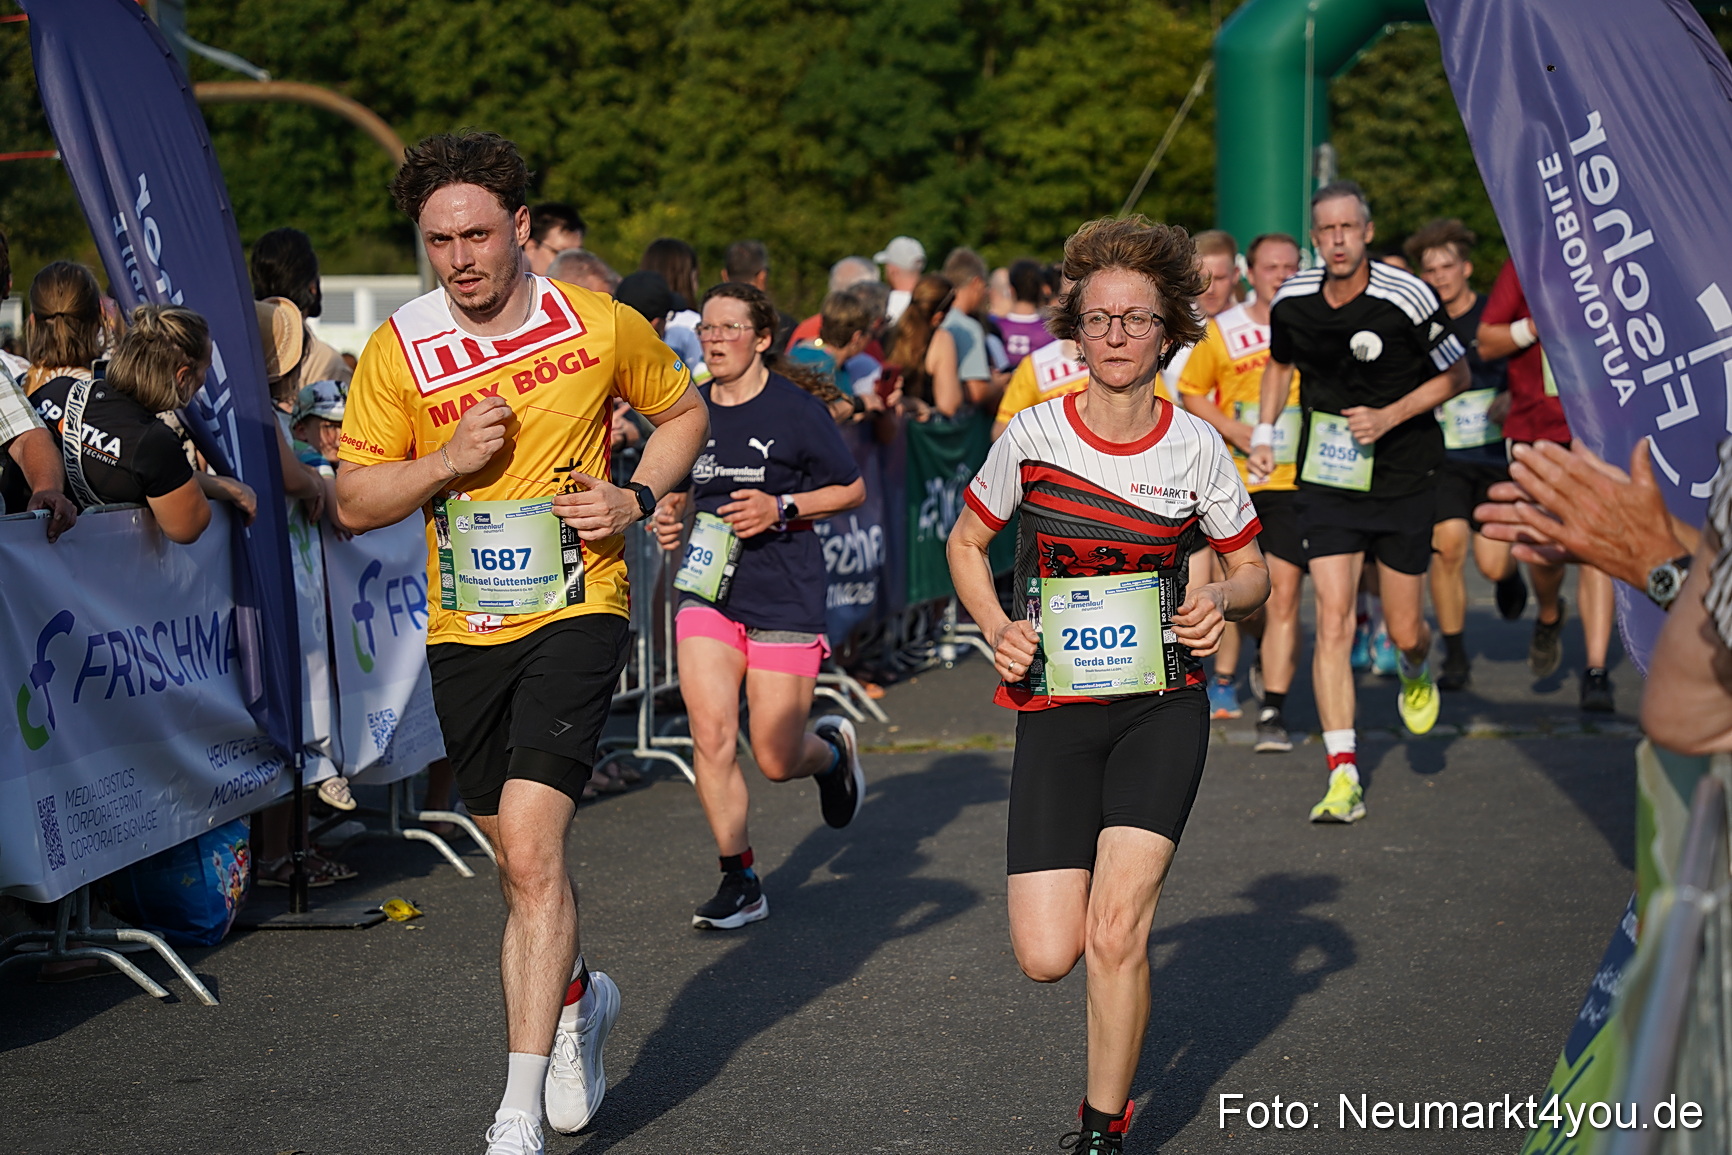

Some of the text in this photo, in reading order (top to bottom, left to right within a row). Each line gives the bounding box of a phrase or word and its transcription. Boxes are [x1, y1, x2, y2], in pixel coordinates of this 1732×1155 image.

[427, 347, 601, 428] MAX BÖGL
[82, 446, 118, 466] TECHNIK
[1130, 482, 1188, 499] NEUMARKT
[470, 522, 504, 531] Firmenlauf
[471, 547, 532, 571] 1687
[458, 573, 559, 587] Michael Guttenberger
[1028, 586, 1040, 594] AOK
[385, 571, 429, 636] FR
[1067, 599, 1104, 610] Firmenlauf
[1161, 613, 1167, 622] 20
[1061, 624, 1138, 651] 2602
[73, 606, 243, 704] FRISCHMA
[1074, 656, 1133, 667] Gerda Benz
[1165, 646, 1177, 681] HILTL
[206, 738, 245, 771] HEUTE
[208, 768, 262, 809] MORGEN
